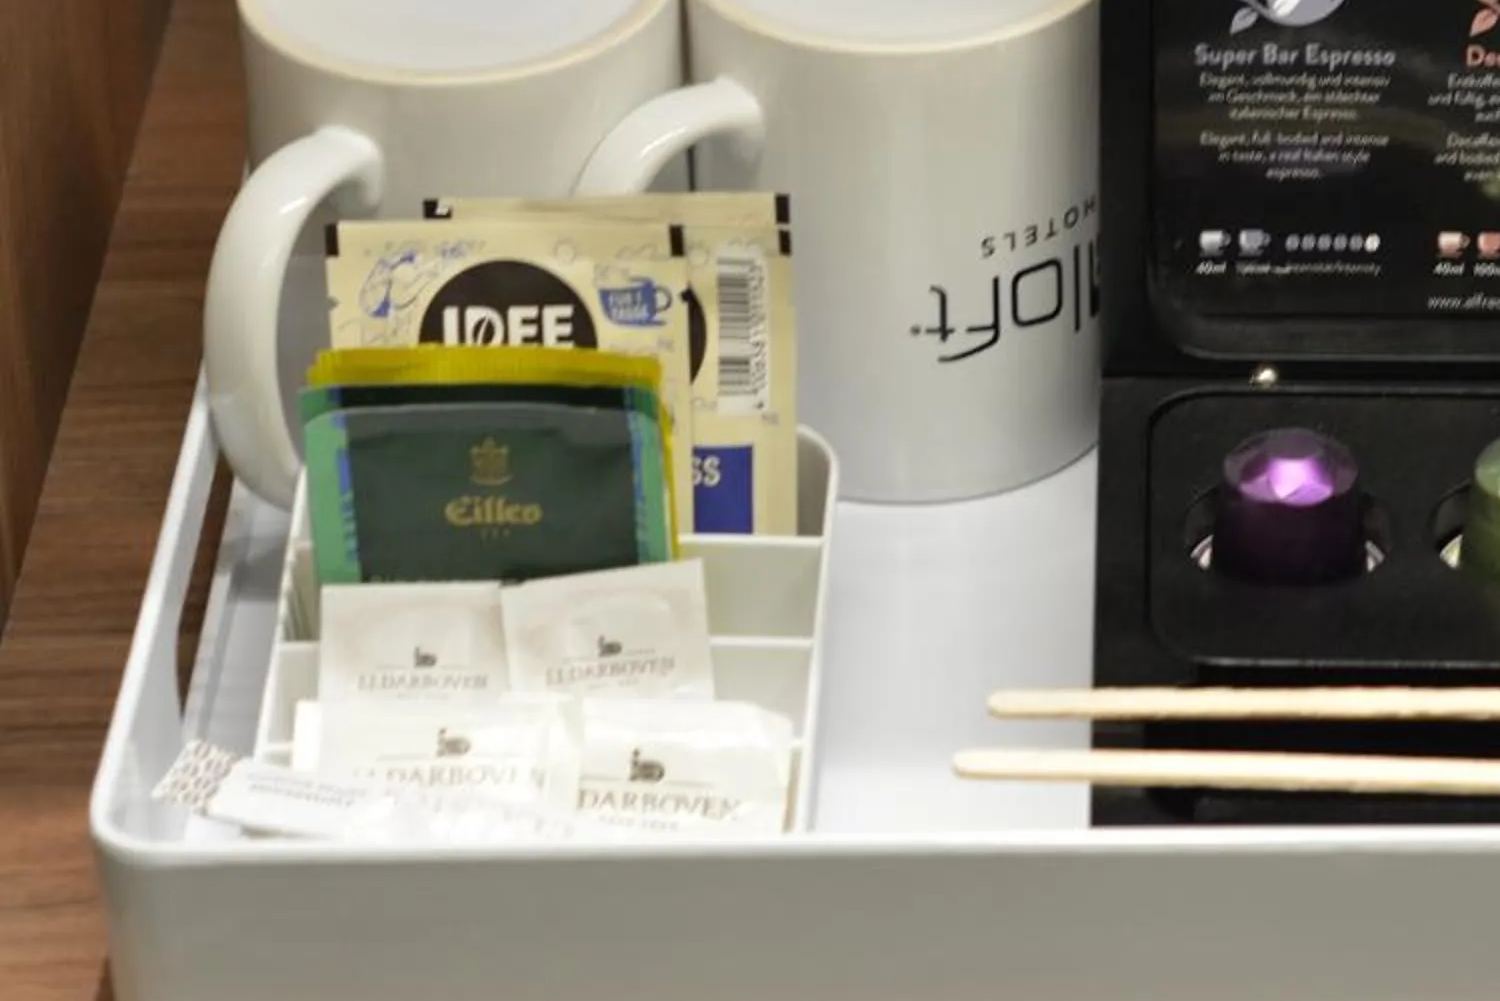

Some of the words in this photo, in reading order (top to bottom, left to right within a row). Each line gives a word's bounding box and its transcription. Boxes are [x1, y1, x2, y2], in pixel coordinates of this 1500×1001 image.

[1194, 42, 1256, 71] Super
[1263, 42, 1299, 65] Bar
[1305, 42, 1397, 71] Espresso
[979, 195, 1097, 259] HOTELS
[443, 304, 576, 348] IDEE
